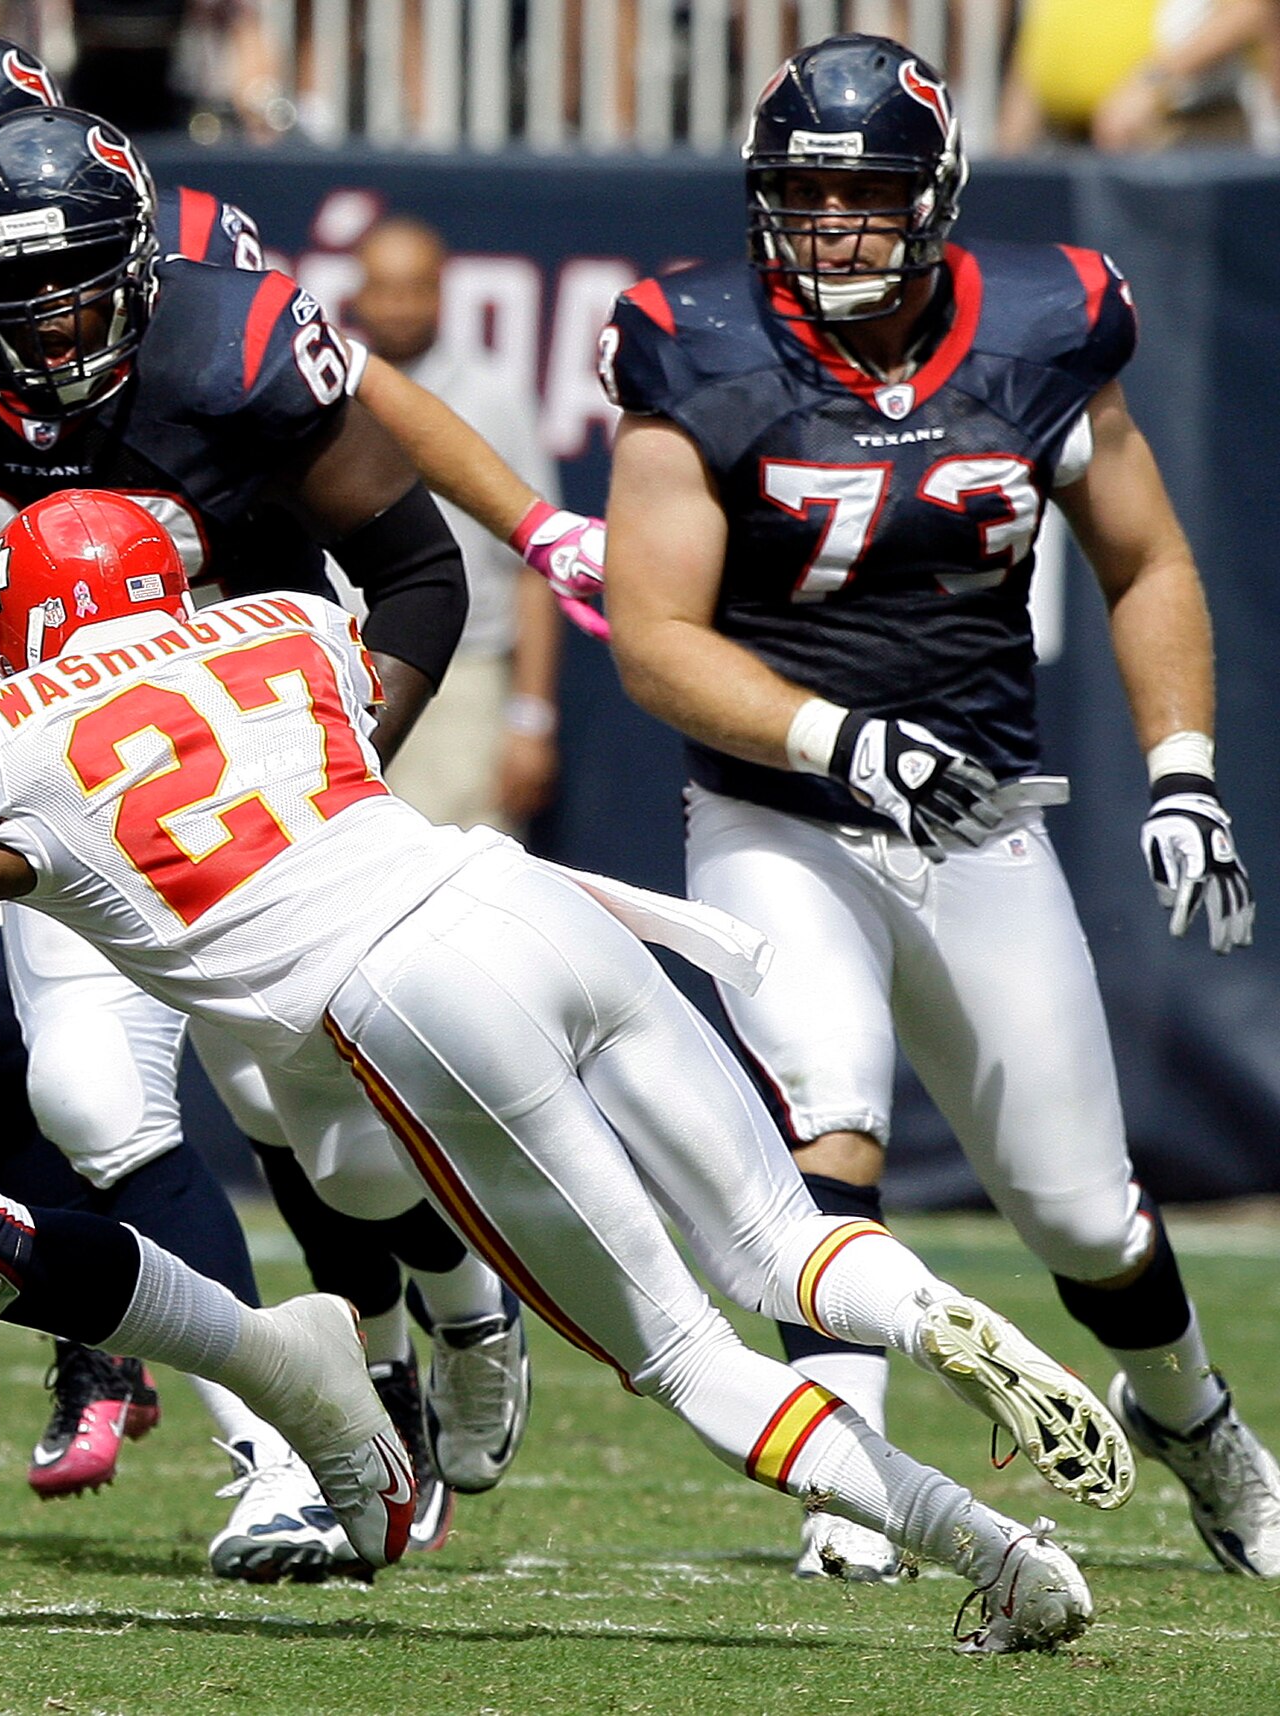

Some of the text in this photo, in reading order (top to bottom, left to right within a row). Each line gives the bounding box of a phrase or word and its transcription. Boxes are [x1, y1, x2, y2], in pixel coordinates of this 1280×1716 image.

[4, 463, 94, 477] TEXANS
[852, 426, 947, 448] TEXANS
[758, 450, 1040, 605] 73
[64, 631, 392, 929] 27
